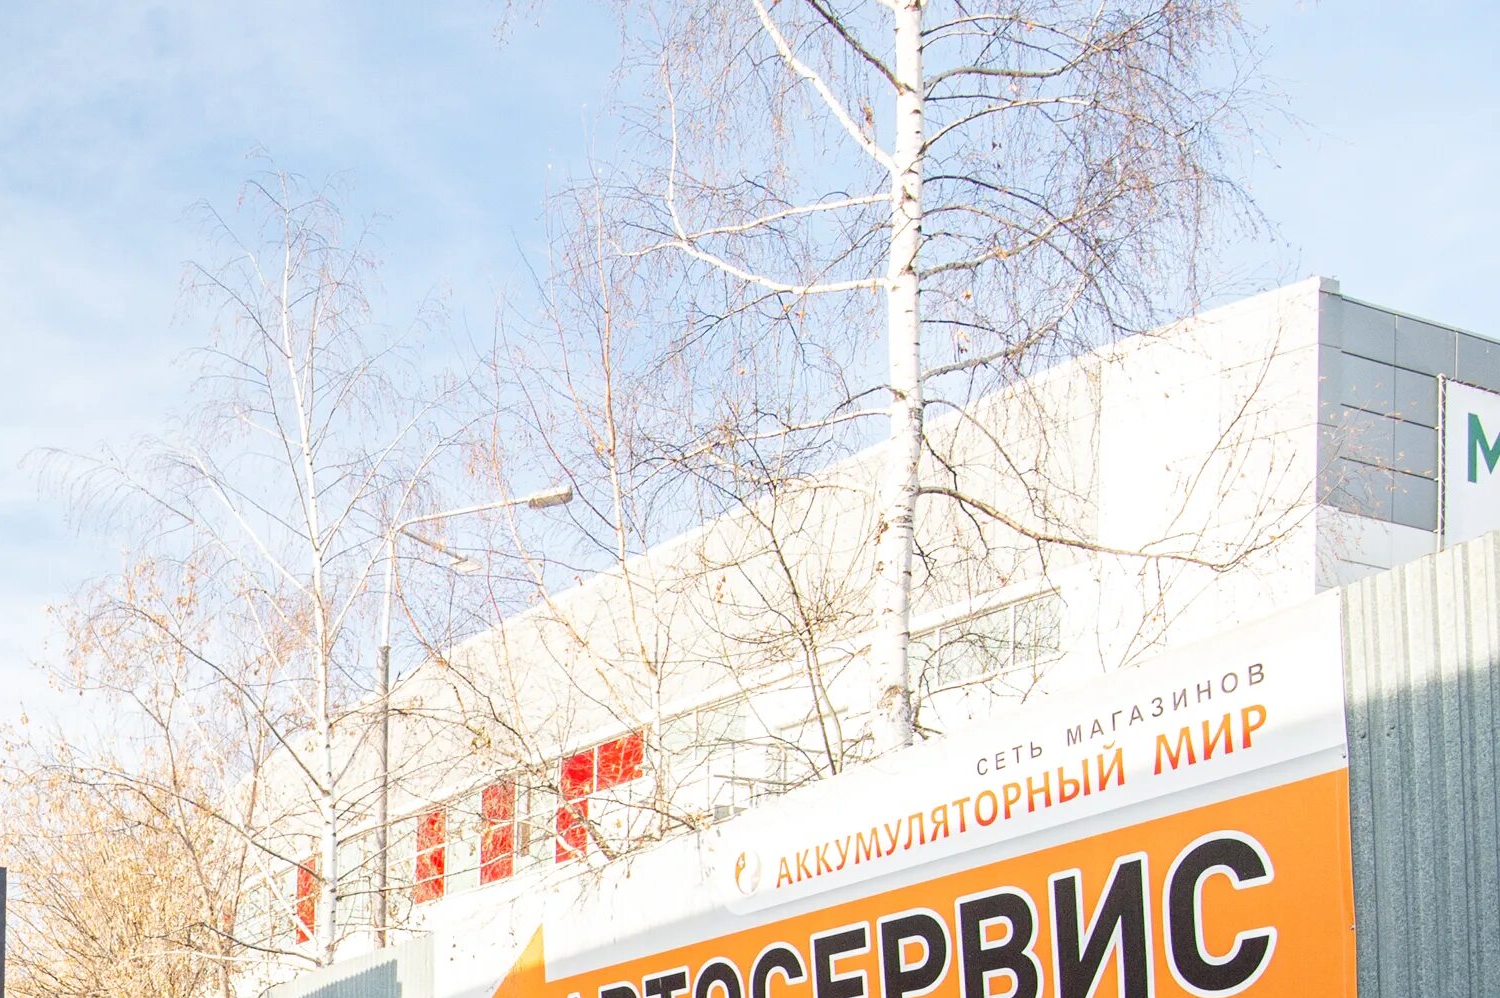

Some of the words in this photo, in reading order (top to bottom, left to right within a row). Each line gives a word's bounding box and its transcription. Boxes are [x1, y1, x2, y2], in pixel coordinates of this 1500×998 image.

[977, 741, 1043, 776] СЕТЬ
[1066, 662, 1265, 745] МАГАЗИНОВ
[776, 743, 1126, 889] АККУМУЛЯТОРНЫЙ
[1153, 703, 1268, 776] МИР
